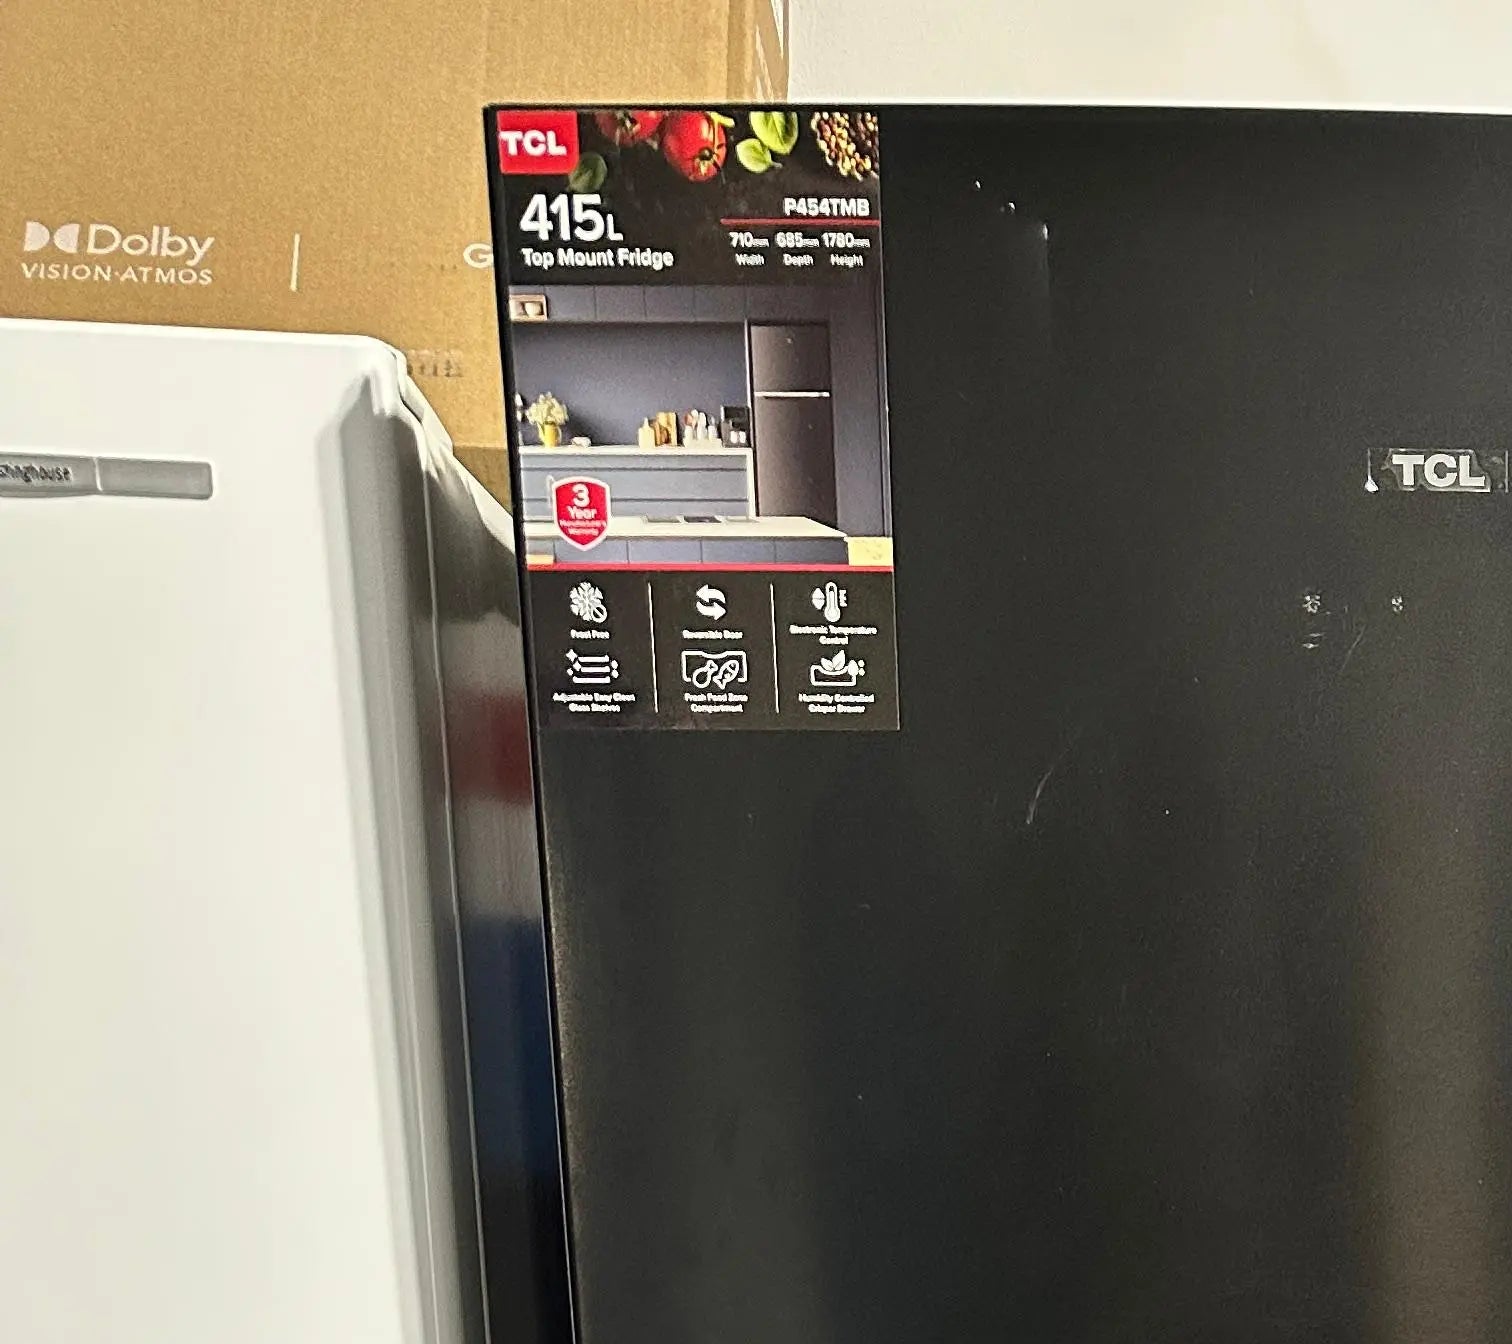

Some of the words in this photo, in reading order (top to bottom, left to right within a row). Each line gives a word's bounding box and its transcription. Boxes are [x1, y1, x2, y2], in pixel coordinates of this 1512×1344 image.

[499, 130, 567, 156] TCL
[519, 193, 624, 242] 415L
[784, 197, 871, 217] P454TMB
[87, 223, 215, 266] Dolby
[521, 248, 554, 270] Top
[556, 248, 615, 267] Mount
[617, 248, 674, 271] Fridge
[1392, 454, 1486, 487] TCL
[572, 483, 590, 508] 3
[566, 505, 598, 520] Year
